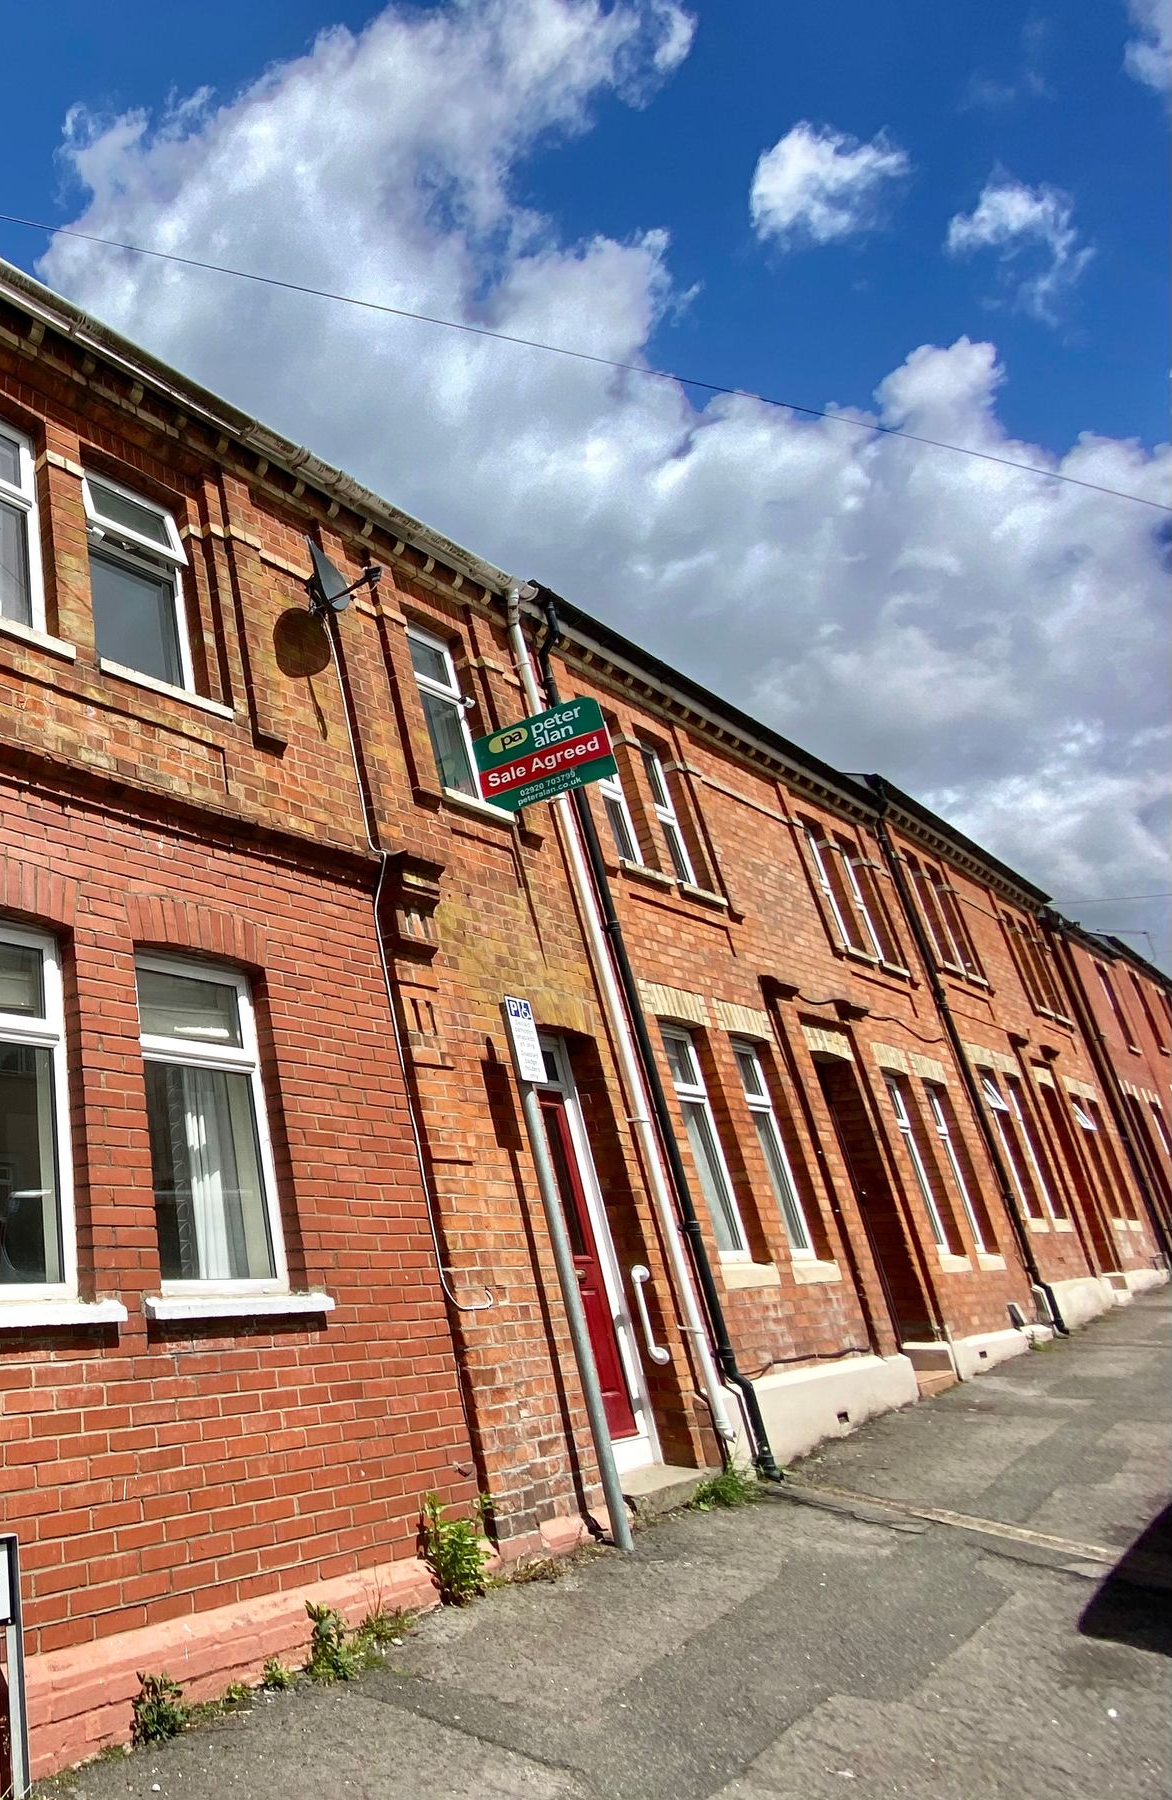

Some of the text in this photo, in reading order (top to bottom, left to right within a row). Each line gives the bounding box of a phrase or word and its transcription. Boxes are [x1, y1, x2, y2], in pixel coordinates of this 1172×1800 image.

[530, 706, 581, 738] peter
[500, 731, 523, 750] pa
[534, 725, 574, 748] alan
[488, 736, 600, 787] Sale Agreed
[517, 776, 582, 807] peteralan.co.uk
[519, 782, 545, 796] 02920
[510, 1001, 518, 1015] P
